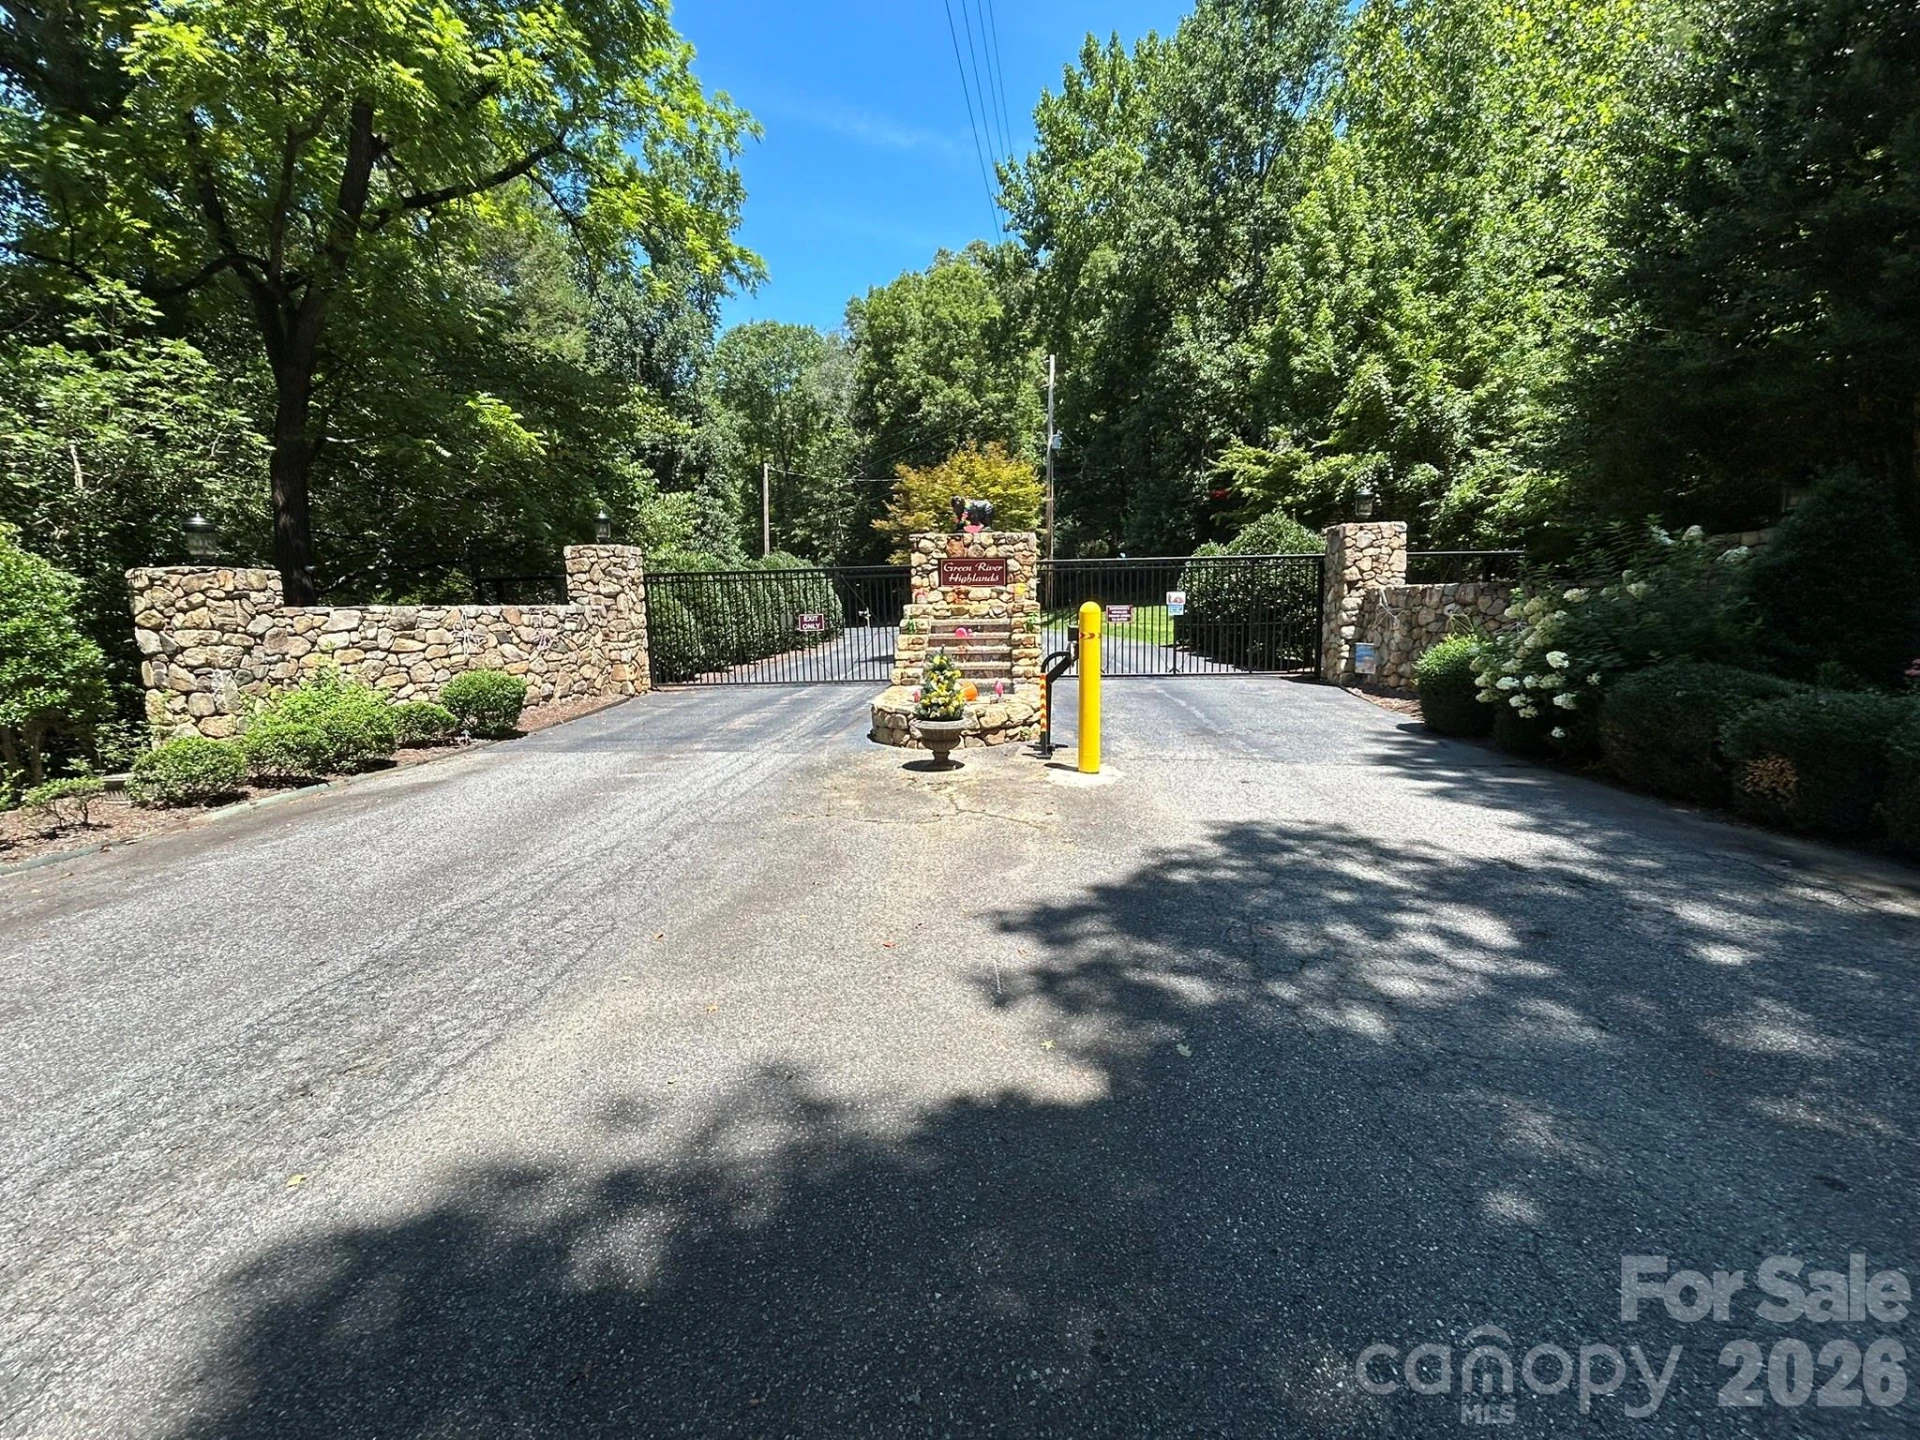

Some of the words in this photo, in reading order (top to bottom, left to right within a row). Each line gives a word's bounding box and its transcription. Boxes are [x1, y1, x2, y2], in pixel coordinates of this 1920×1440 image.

[943, 562, 972, 572] Green
[975, 561, 1003, 571] River
[948, 573, 999, 584] Highlands
